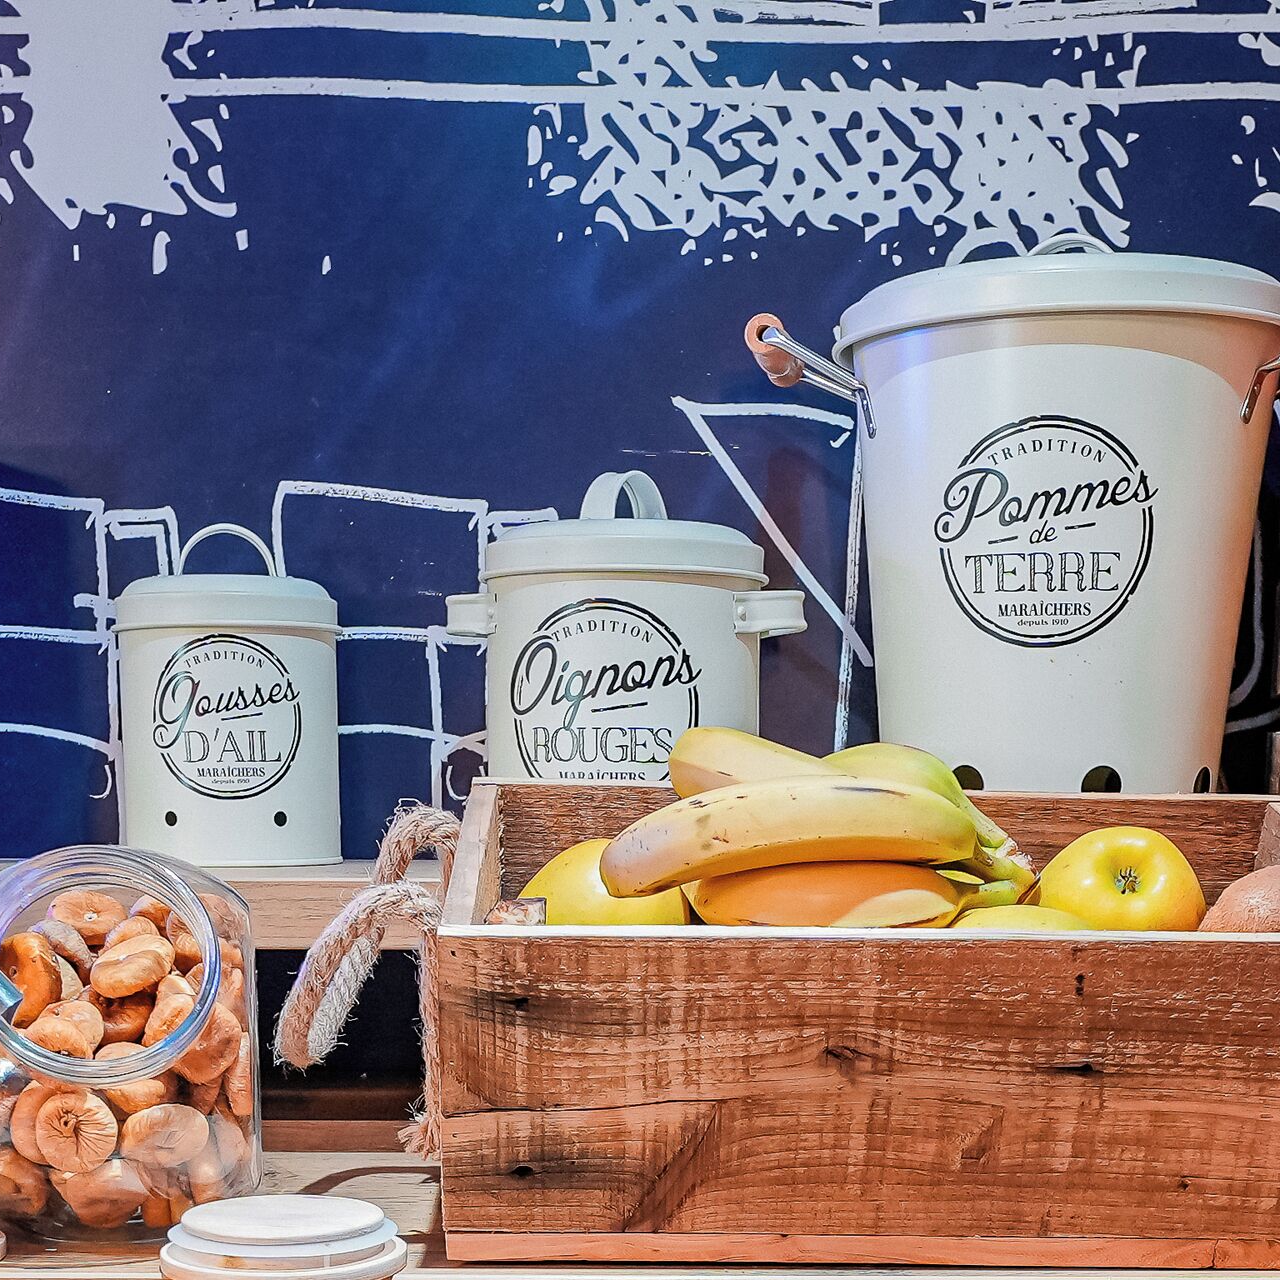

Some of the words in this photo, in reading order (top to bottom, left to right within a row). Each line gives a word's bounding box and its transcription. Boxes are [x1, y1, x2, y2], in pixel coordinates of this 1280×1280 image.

[987, 438, 1107, 467] TRADITION
[933, 467, 1160, 543] Pommes
[1029, 520, 1058, 545] de
[965, 551, 1121, 594] TERRE
[998, 600, 1092, 617] MARAÎCHERS
[1017, 617, 1049, 627] depuis
[551, 619, 654, 644] TRADITION
[183, 650, 266, 669] TRADITION
[510, 634, 703, 732] Oignons
[182, 727, 282, 763] D'AIL
[531, 727, 673, 763] ROUGES
